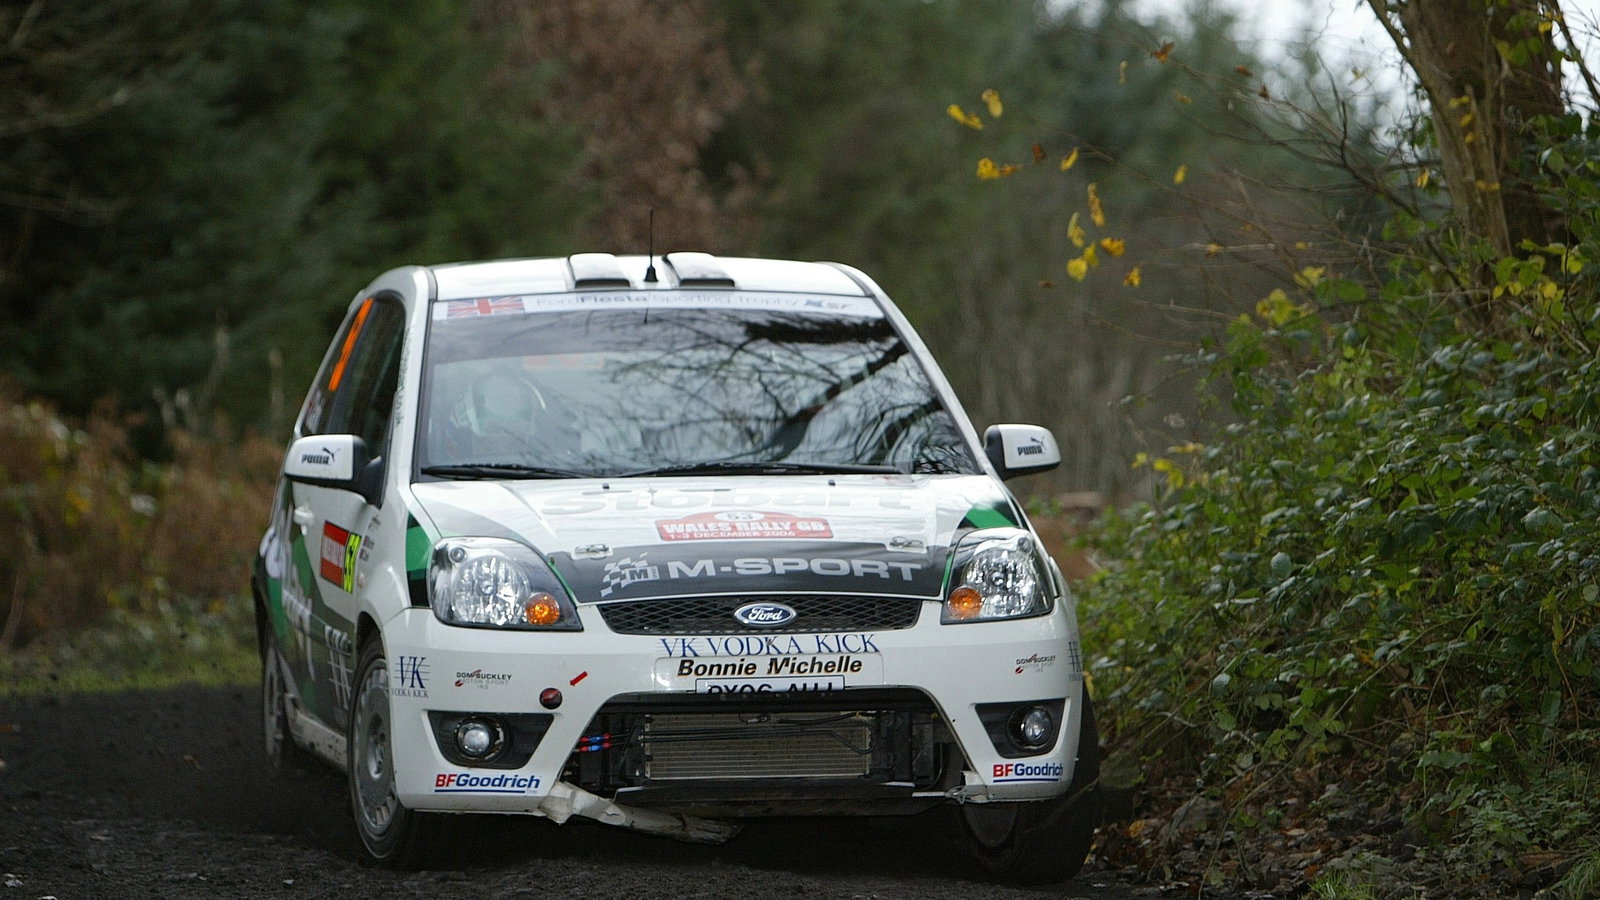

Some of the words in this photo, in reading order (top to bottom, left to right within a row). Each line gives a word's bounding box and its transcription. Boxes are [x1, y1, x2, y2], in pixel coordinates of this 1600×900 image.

[302, 453, 330, 464] PUMA
[1017, 445, 1043, 456] PUMA
[663, 521, 732, 534] WALES
[736, 520, 793, 533] RALLY
[796, 520, 826, 532] GB
[694, 530, 760, 539] DECEMBER
[763, 530, 797, 538] 2006
[667, 557, 922, 582] M-SPORT
[748, 606, 783, 621] Ford
[659, 637, 699, 657] VK
[706, 635, 804, 656] VODKA
[815, 633, 881, 654] KICK
[398, 655, 427, 689] VK
[677, 657, 757, 677] Bonnie
[767, 655, 863, 675] Michelle
[992, 762, 1064, 778] BFGoodrich
[434, 773, 541, 789] BFGoodrich
